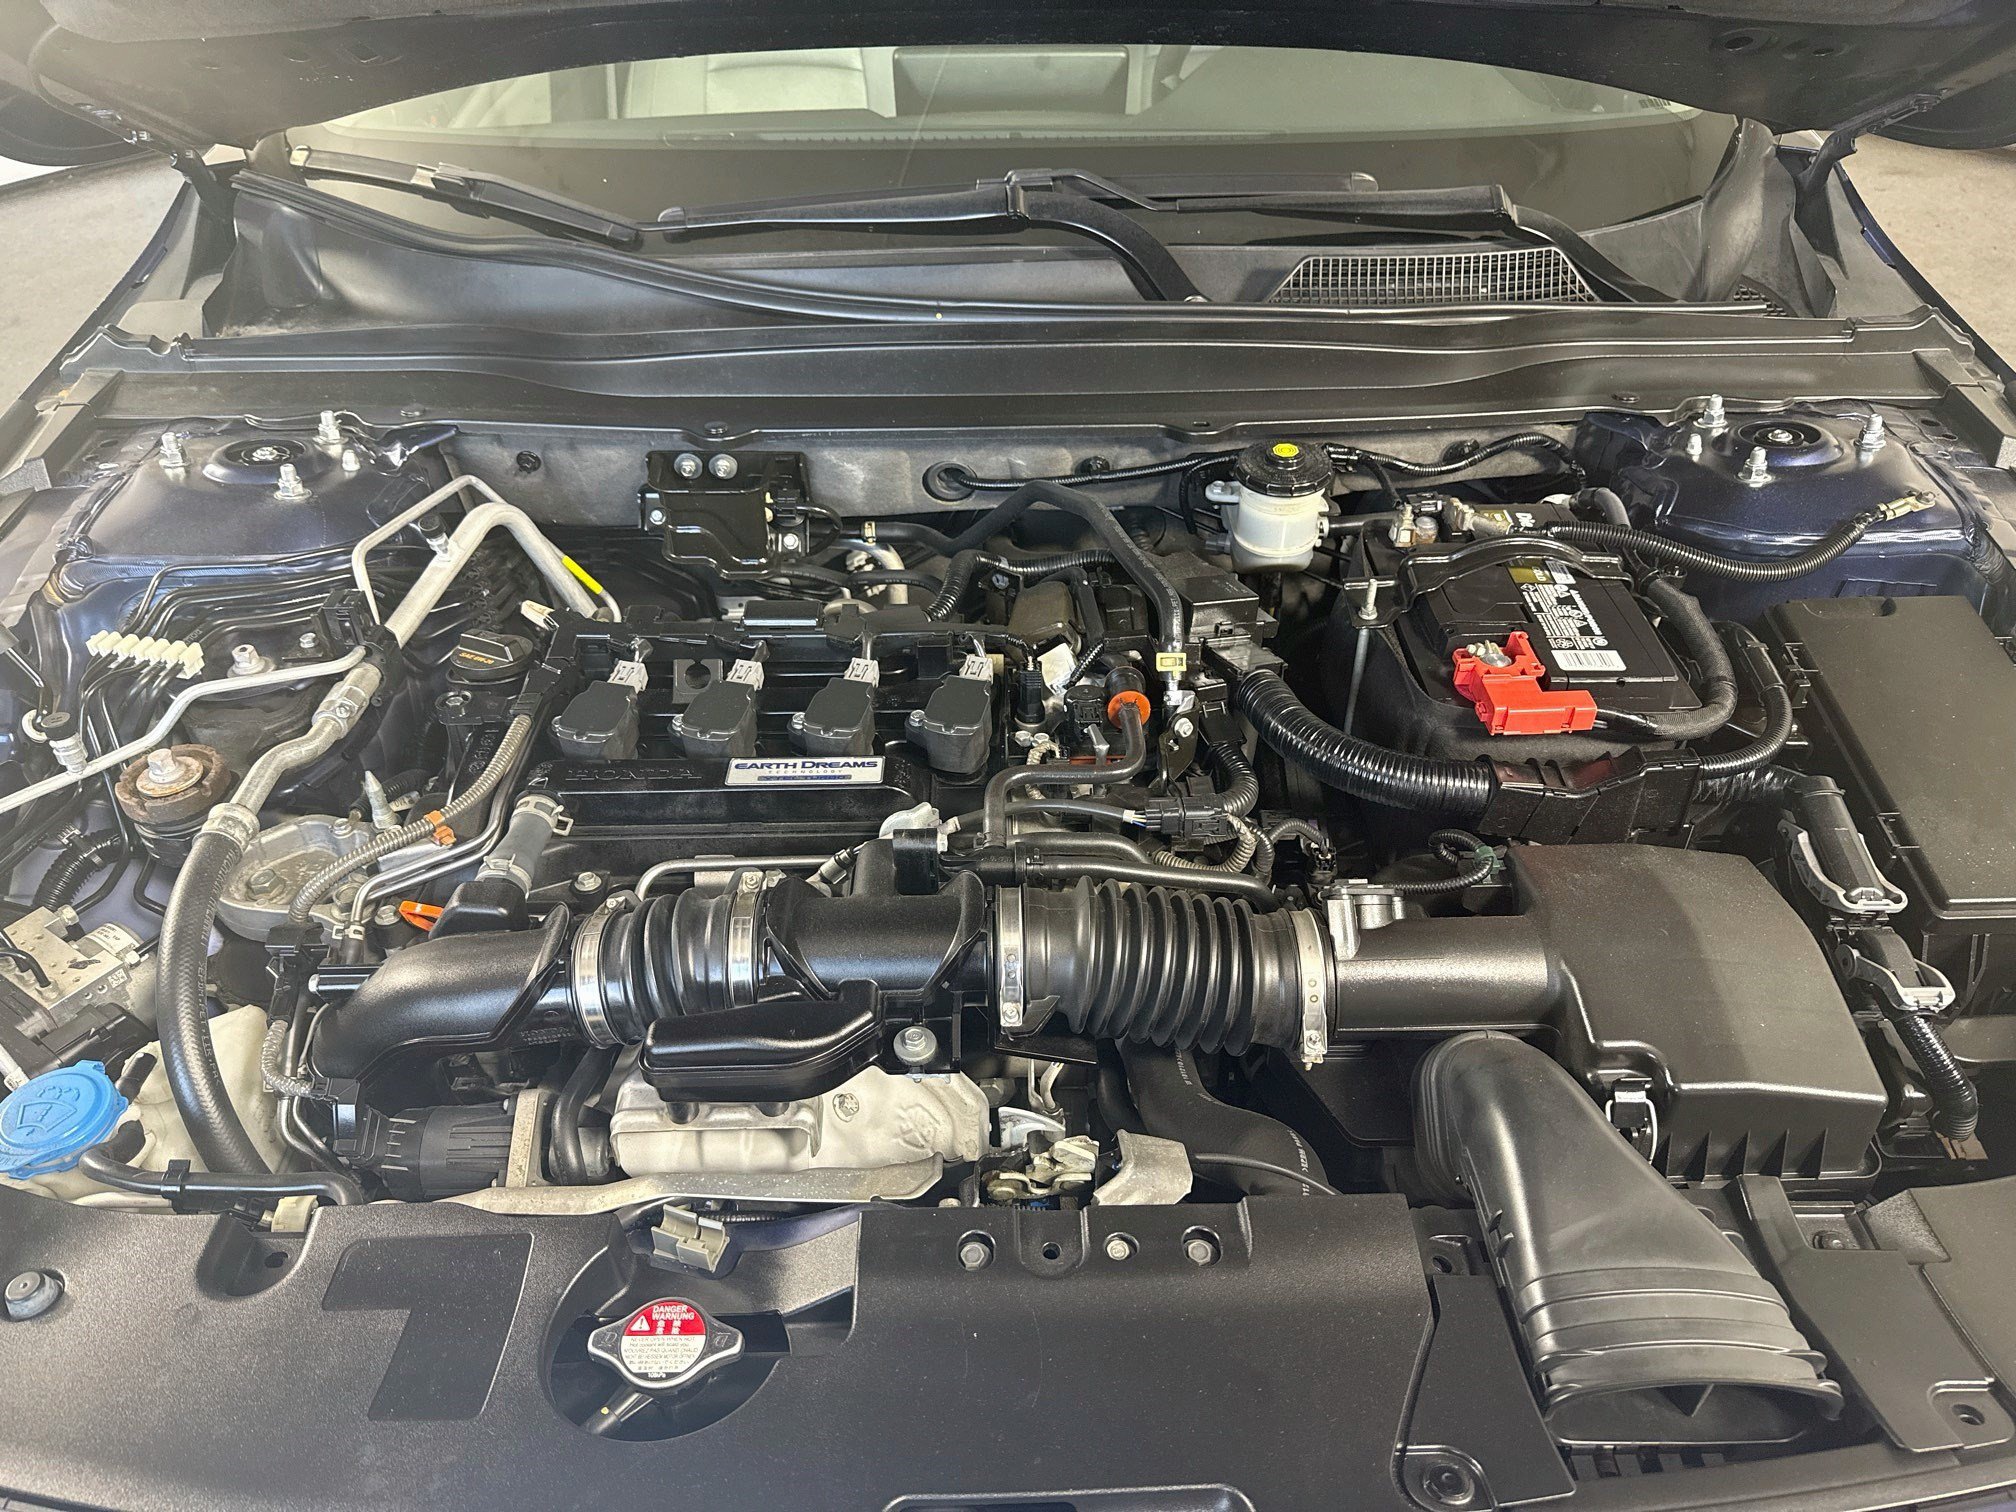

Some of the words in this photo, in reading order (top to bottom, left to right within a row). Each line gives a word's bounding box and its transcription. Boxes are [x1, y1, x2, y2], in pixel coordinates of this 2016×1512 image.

[734, 761, 797, 770] EARTH
[801, 760, 878, 769] DREAMS
[565, 768, 702, 781] HONDA
[652, 1312, 695, 1320] WARNUNG
